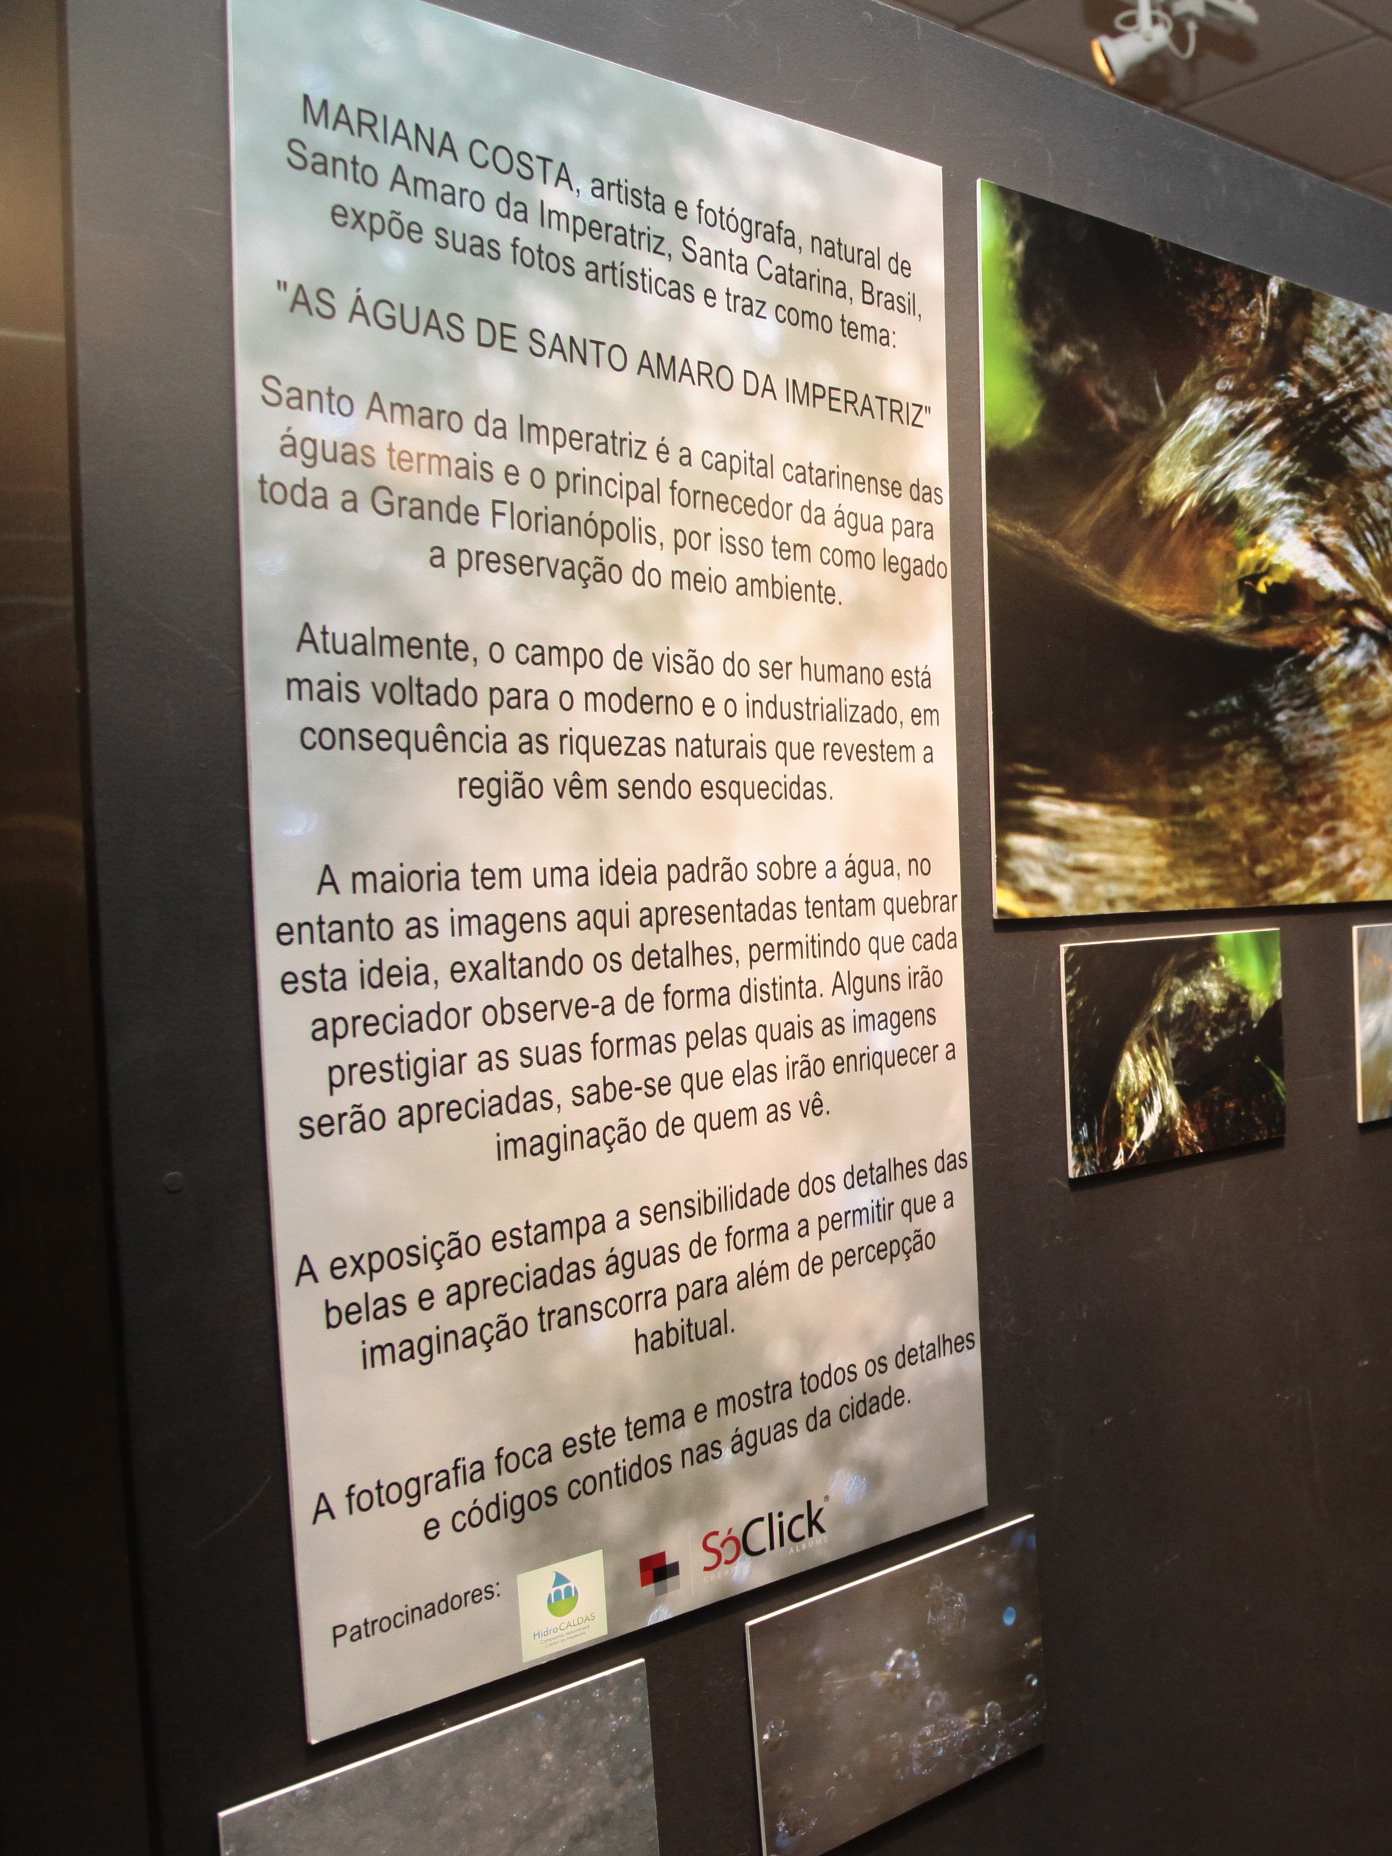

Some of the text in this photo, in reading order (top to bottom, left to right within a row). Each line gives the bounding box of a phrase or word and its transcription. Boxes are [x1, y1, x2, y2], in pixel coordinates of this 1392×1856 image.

[303, 94, 911, 278] MARIANA COSTA, artista e fotógrafa, natural de
[287, 139, 921, 321] Santo Amaro da Imperatriz, Santa Catarina, Brasil,
[331, 204, 897, 347] expõe suas fotos artísticas e traz como tema:
[277, 280, 930, 428] "AS ÁGUAS DE SANTO AMARO DA IMPERATRIZ"
[262, 375, 942, 504] Santo Amaro da Imperatriz é a capital catarinense das
[259, 475, 947, 581] toda a Grande Florianópolis, por isso tem como legado
[430, 546, 841, 605] a preservação do meio ambiente.
[296, 622, 931, 688] Atualmente, o campo de visão do ser humano está
[287, 672, 939, 728] mais voltado para o moderno e o industrializado, em
[459, 770, 832, 807] região vêm sendo esquecidas.
[317, 853, 931, 895] A maioria tem uma ideia padrão sobre a água, no
[281, 926, 957, 995] esta ideia, exaltando os detalhes, permitindo que cada
[311, 965, 942, 1048] apreciador observe-a de forma distinta. Alguns irão
[328, 1008, 936, 1096] prestigiar as suas formas pelas quais as imagens
[497, 1091, 829, 1161] imaginação de quem as vê.
[325, 1191, 954, 1329] belas e apreciadas águas de forma a permitir que a
[362, 1229, 935, 1370] imaginação transcorra para além de percepção
[635, 1309, 734, 1355] habitual.
[312, 1332, 975, 1525] A fotografia foca este tema e mostra todos os detalhes
[424, 1385, 910, 1540] e códigos contidos nas águas da cidade.
[788, 1535, 828, 1555] ALBUMS
[333, 1582, 500, 1647] Patrocinadores:
